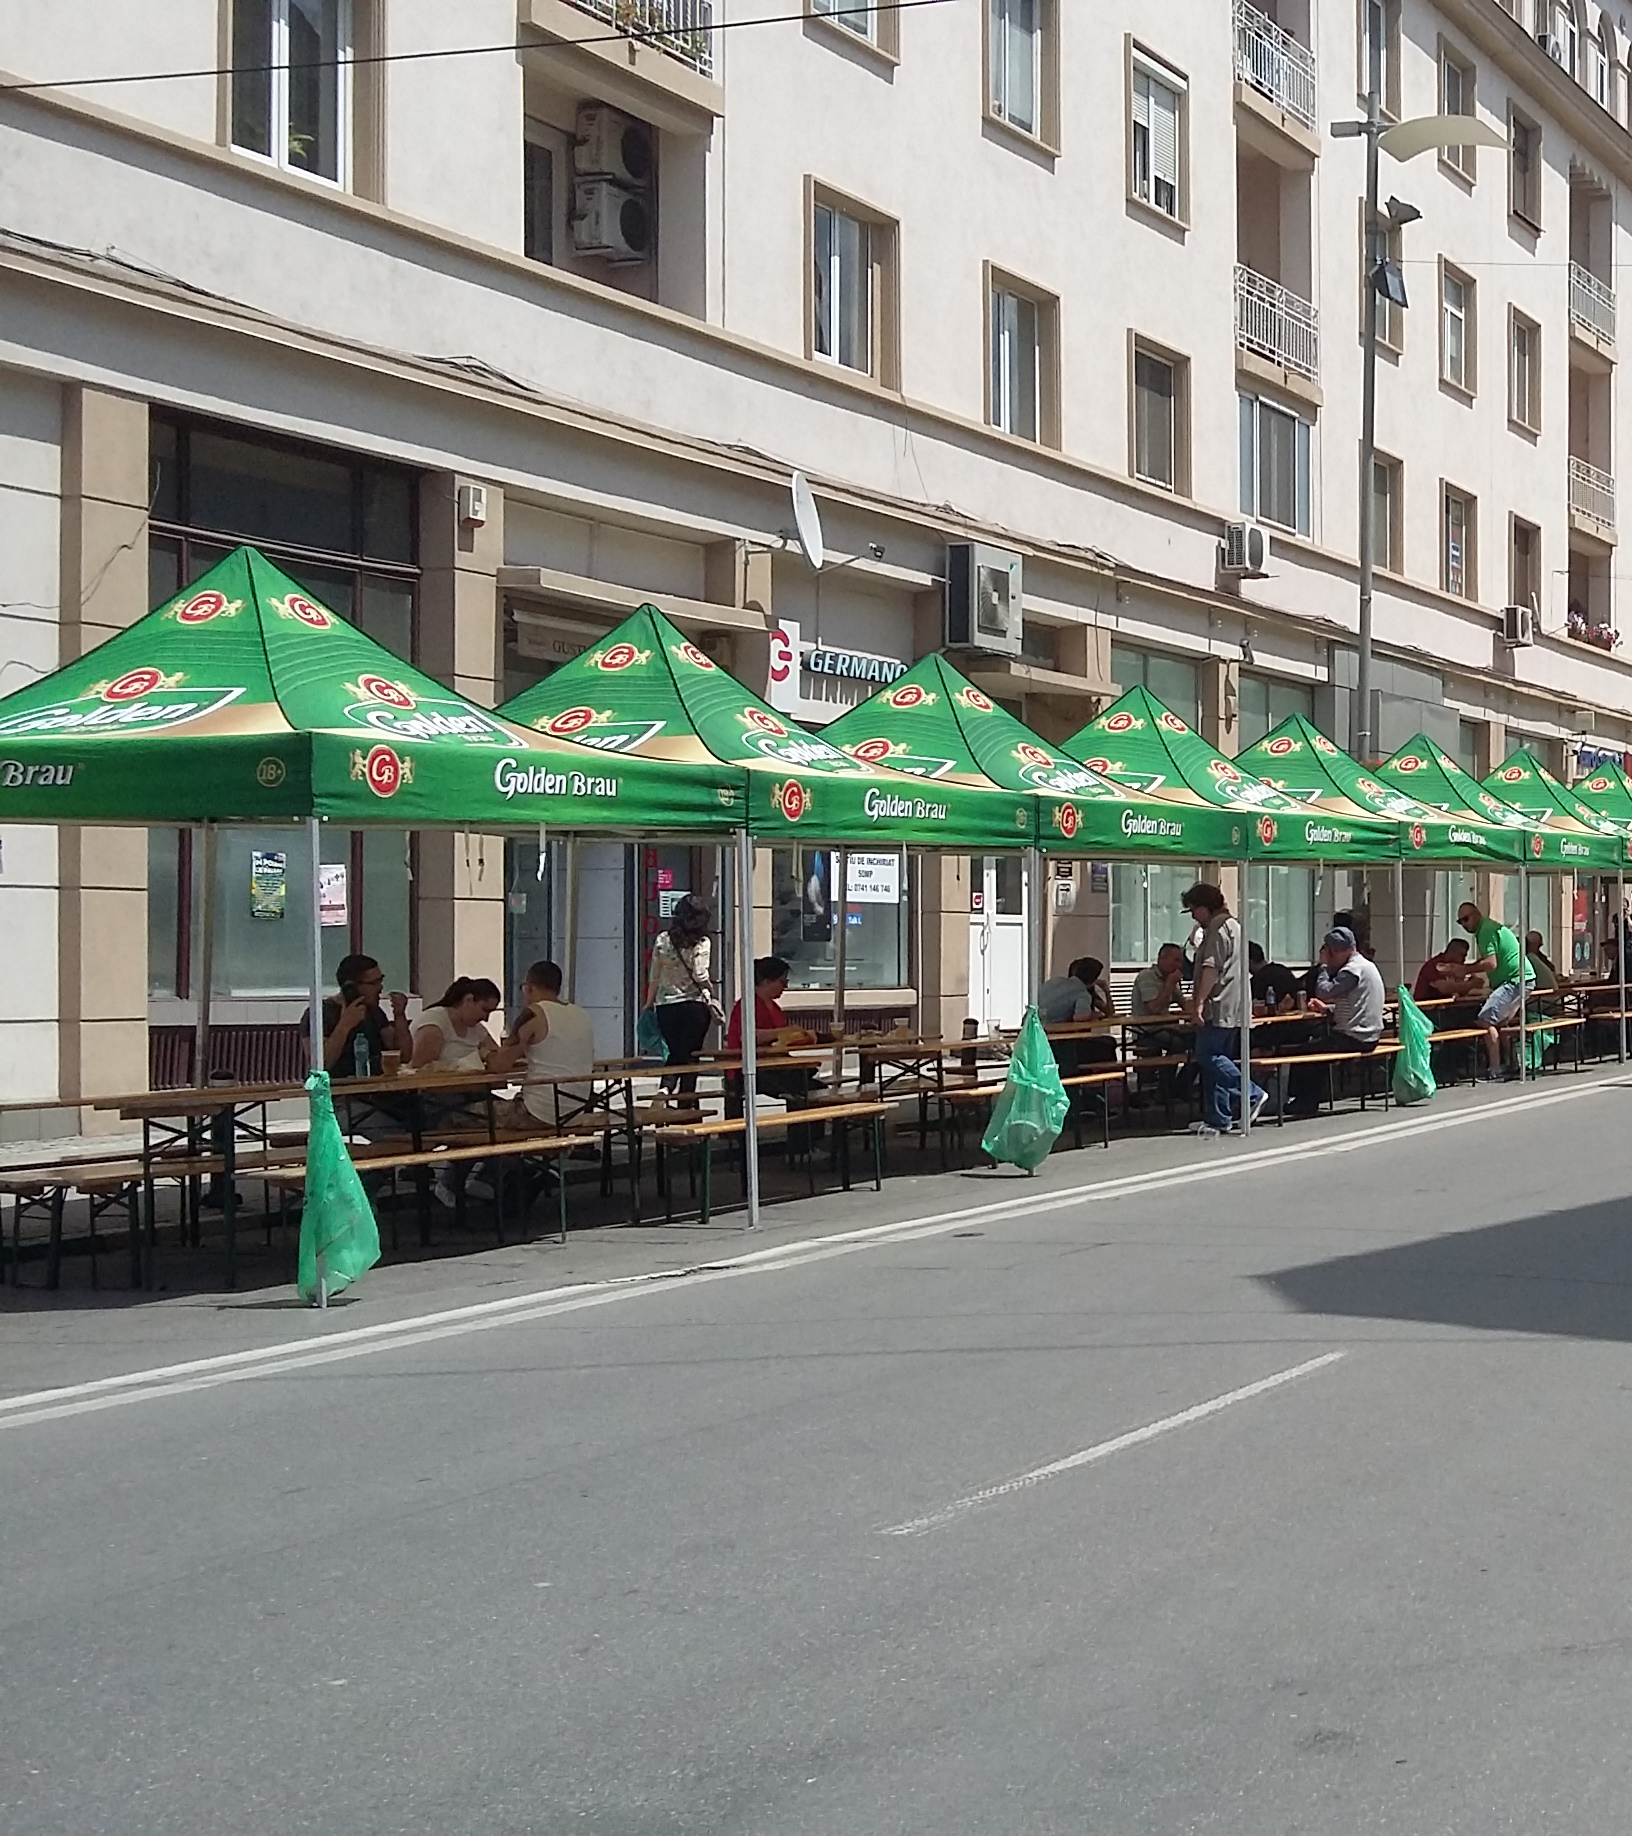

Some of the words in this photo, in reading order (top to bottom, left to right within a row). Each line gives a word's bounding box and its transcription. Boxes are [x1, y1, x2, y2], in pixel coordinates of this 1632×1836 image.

[809, 650, 908, 684] GERMANO
[0, 701, 198, 735] Golden
[366, 710, 493, 739] Golden
[758, 739, 846, 766] Golden
[0, 760, 74, 787] Brau
[494, 757, 567, 801] Golden
[568, 771, 618, 797] Brau
[863, 787, 914, 822] Golden
[914, 798, 948, 820] Brau
[1121, 809, 1157, 838] Golden
[1158, 818, 1182, 837] Brau
[1305, 820, 1332, 845] Golden
